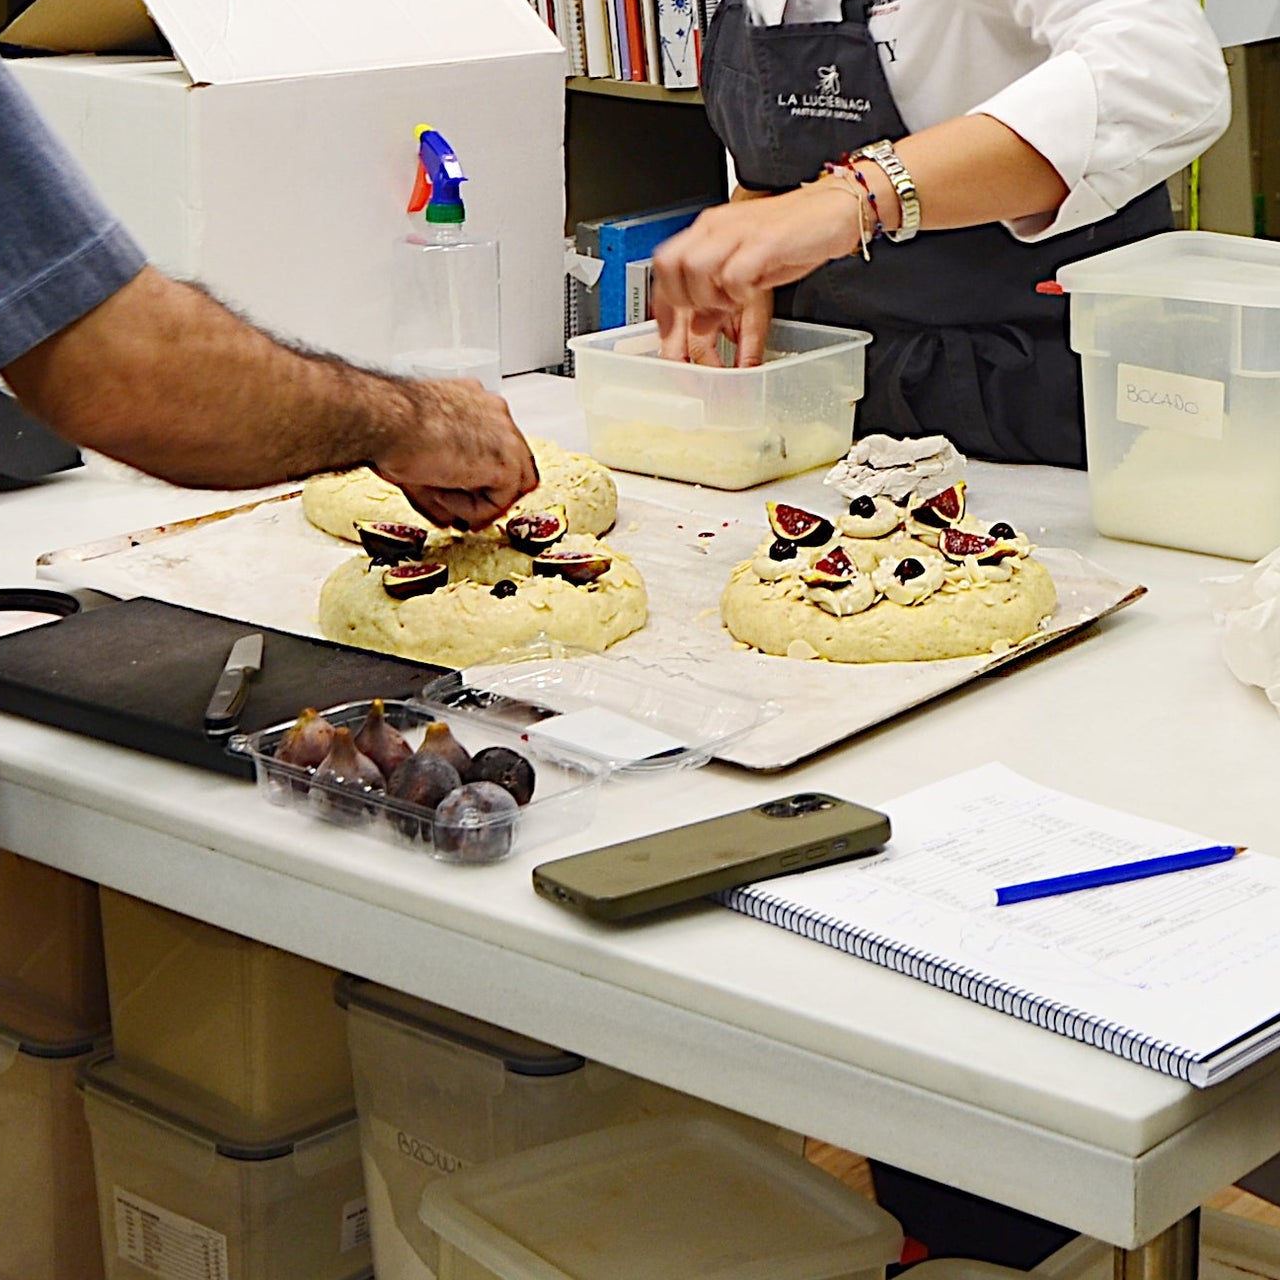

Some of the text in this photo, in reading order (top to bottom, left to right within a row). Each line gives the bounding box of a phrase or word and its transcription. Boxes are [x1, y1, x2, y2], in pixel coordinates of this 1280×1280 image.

[777, 93, 798, 106] LA
[1126, 384, 1199, 415] BOCADO
[397, 1131, 462, 1174] BROW
